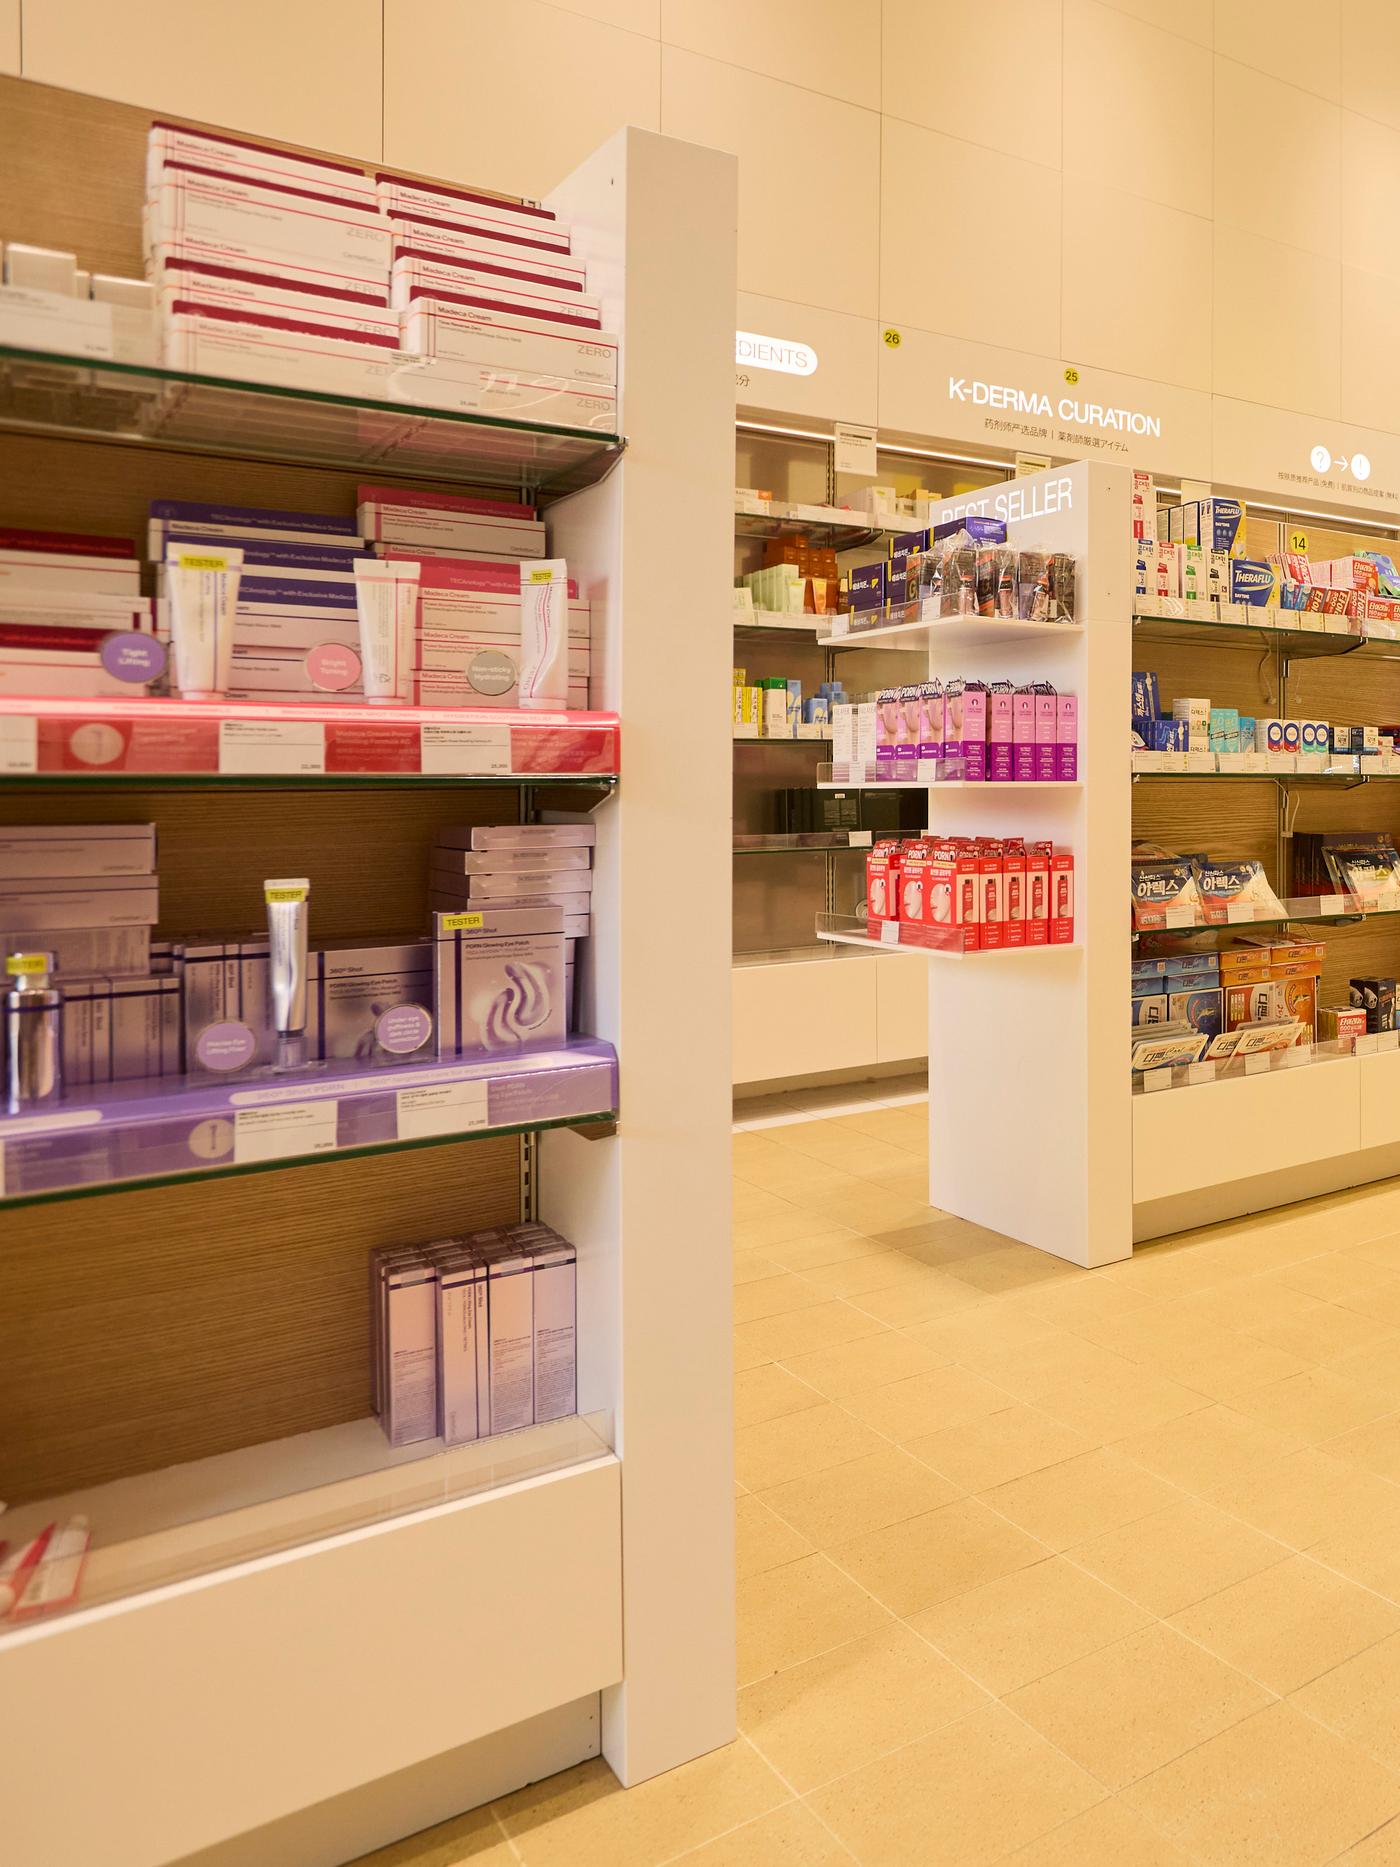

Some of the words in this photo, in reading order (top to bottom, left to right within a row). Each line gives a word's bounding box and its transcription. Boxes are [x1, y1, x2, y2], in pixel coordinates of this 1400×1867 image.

[422, 265, 451, 278] Madeca
[452, 272, 476, 282] Cream
[438, 306, 467, 318] Madeca
[468, 312, 492, 322] Cream
[885, 332, 900, 345] 26
[577, 343, 611, 359] ZERO
[736, 338, 808, 369] DIENTS
[1065, 370, 1079, 383] 25
[576, 397, 610, 412] ZERO
[949, 376, 1053, 418] K-DERMA
[1058, 398, 1161, 438] CURATION
[995, 477, 1072, 523] SELLER
[1215, 505, 1240, 515] THERAFLU
[1293, 536, 1306, 550] 14
[183, 556, 225, 568] TESTER
[1235, 570, 1271, 584] THERAFLU
[1137, 880, 1180, 897] 아렉스
[1203, 875, 1241, 891] 아렉스
[270, 890, 303, 900] TESTER
[447, 917, 480, 927] TESTER
